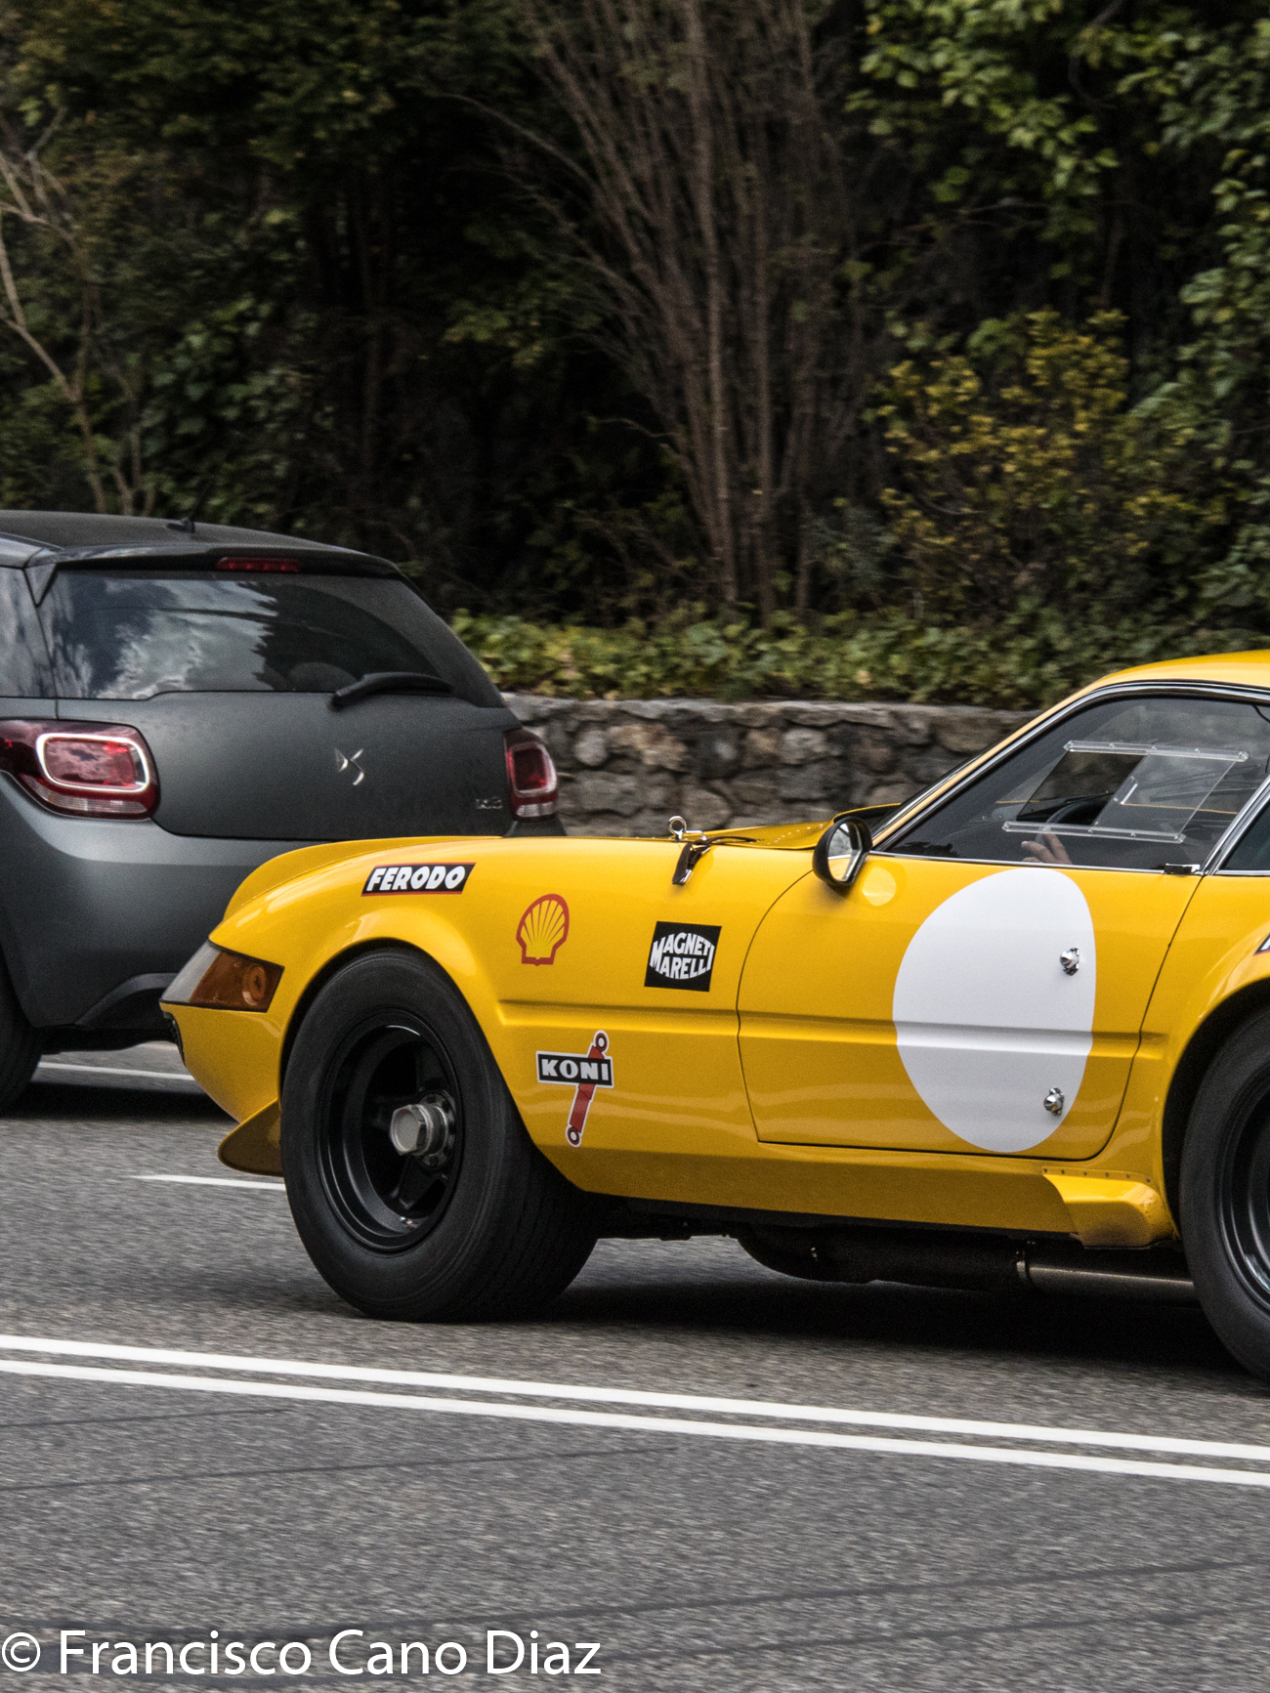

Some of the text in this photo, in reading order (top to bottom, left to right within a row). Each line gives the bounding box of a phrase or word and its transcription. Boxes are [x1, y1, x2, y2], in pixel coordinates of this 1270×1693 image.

[366, 866, 466, 892] FERODO
[650, 932, 715, 958] MAGNETI
[541, 1058, 609, 1081] KONI
